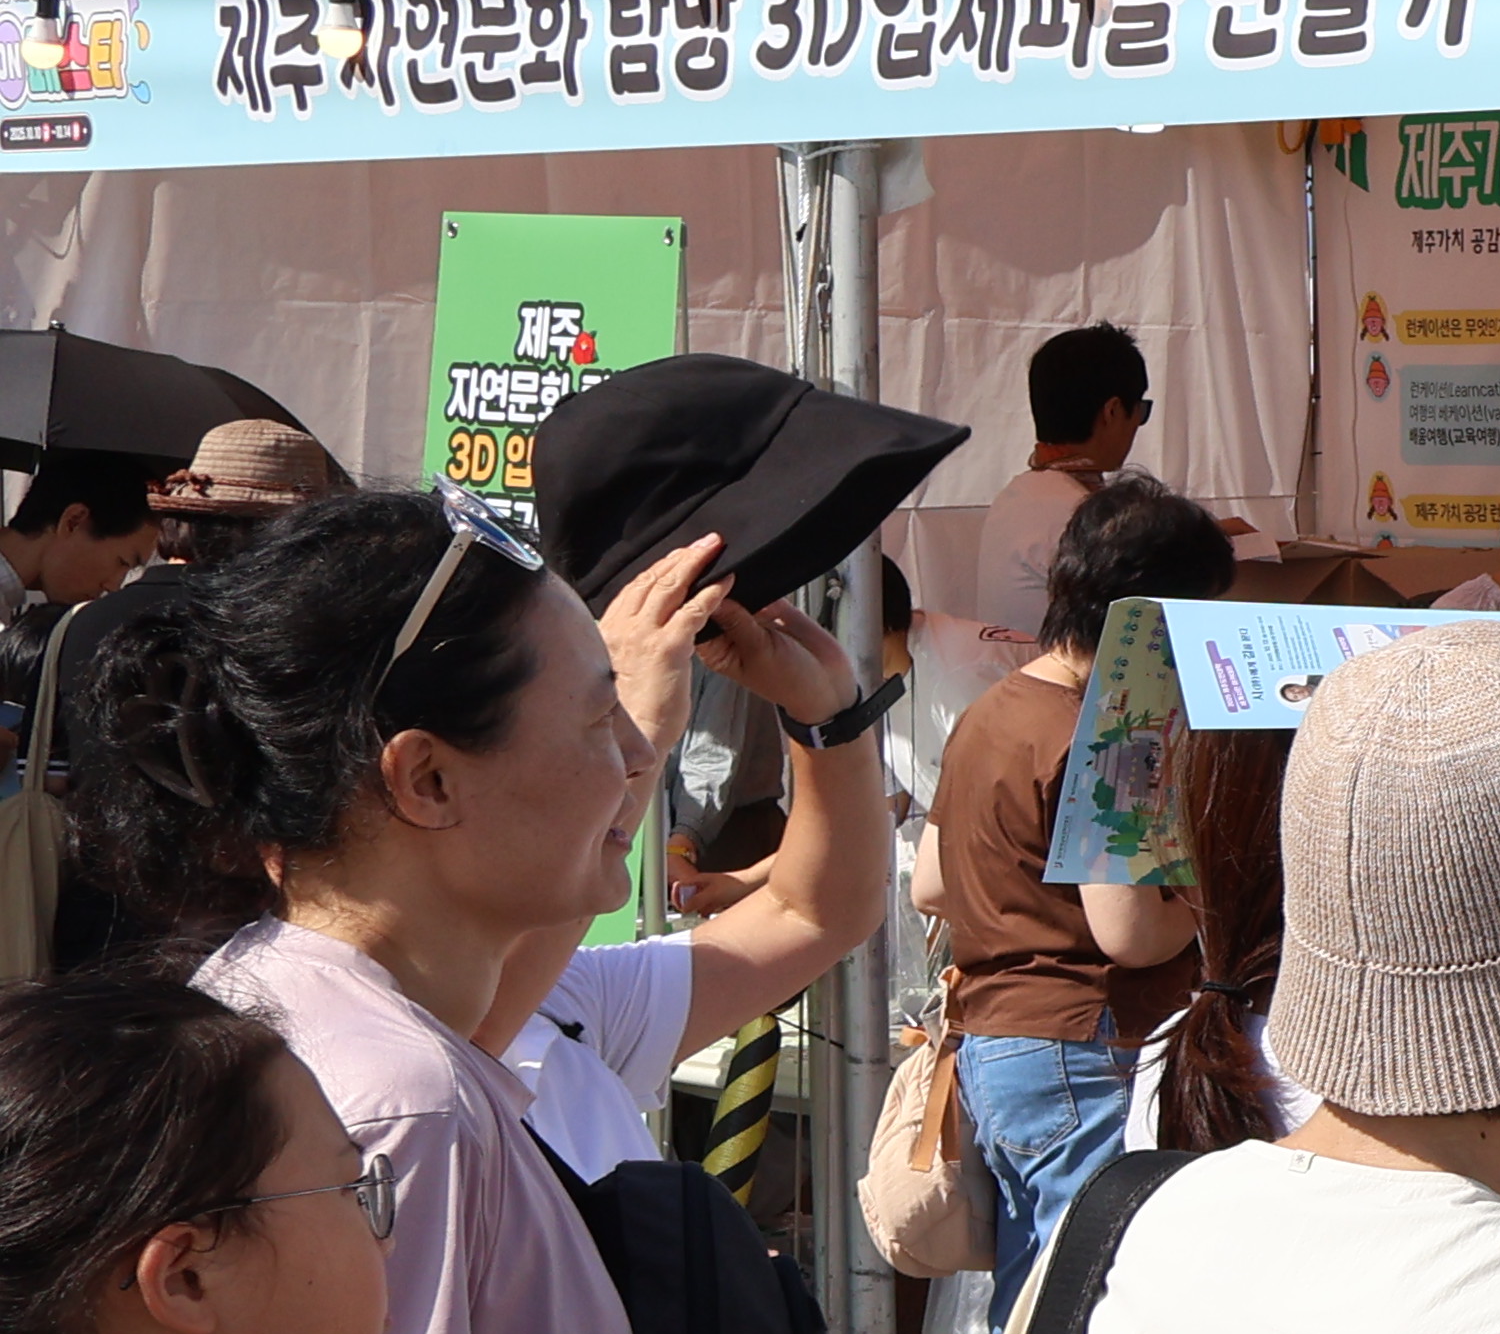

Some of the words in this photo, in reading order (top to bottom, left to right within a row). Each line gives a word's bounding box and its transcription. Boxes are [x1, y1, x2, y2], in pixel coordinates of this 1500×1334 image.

[1411, 228, 1465, 254] 제주가치
[516, 305, 582, 362] 제주
[1405, 318, 1462, 339] 런케이션은
[446, 367, 572, 424] 자연문화
[449, 431, 496, 482] 3D
[1414, 503, 1439, 523] 제주
[1463, 502, 1488, 522] 공감
